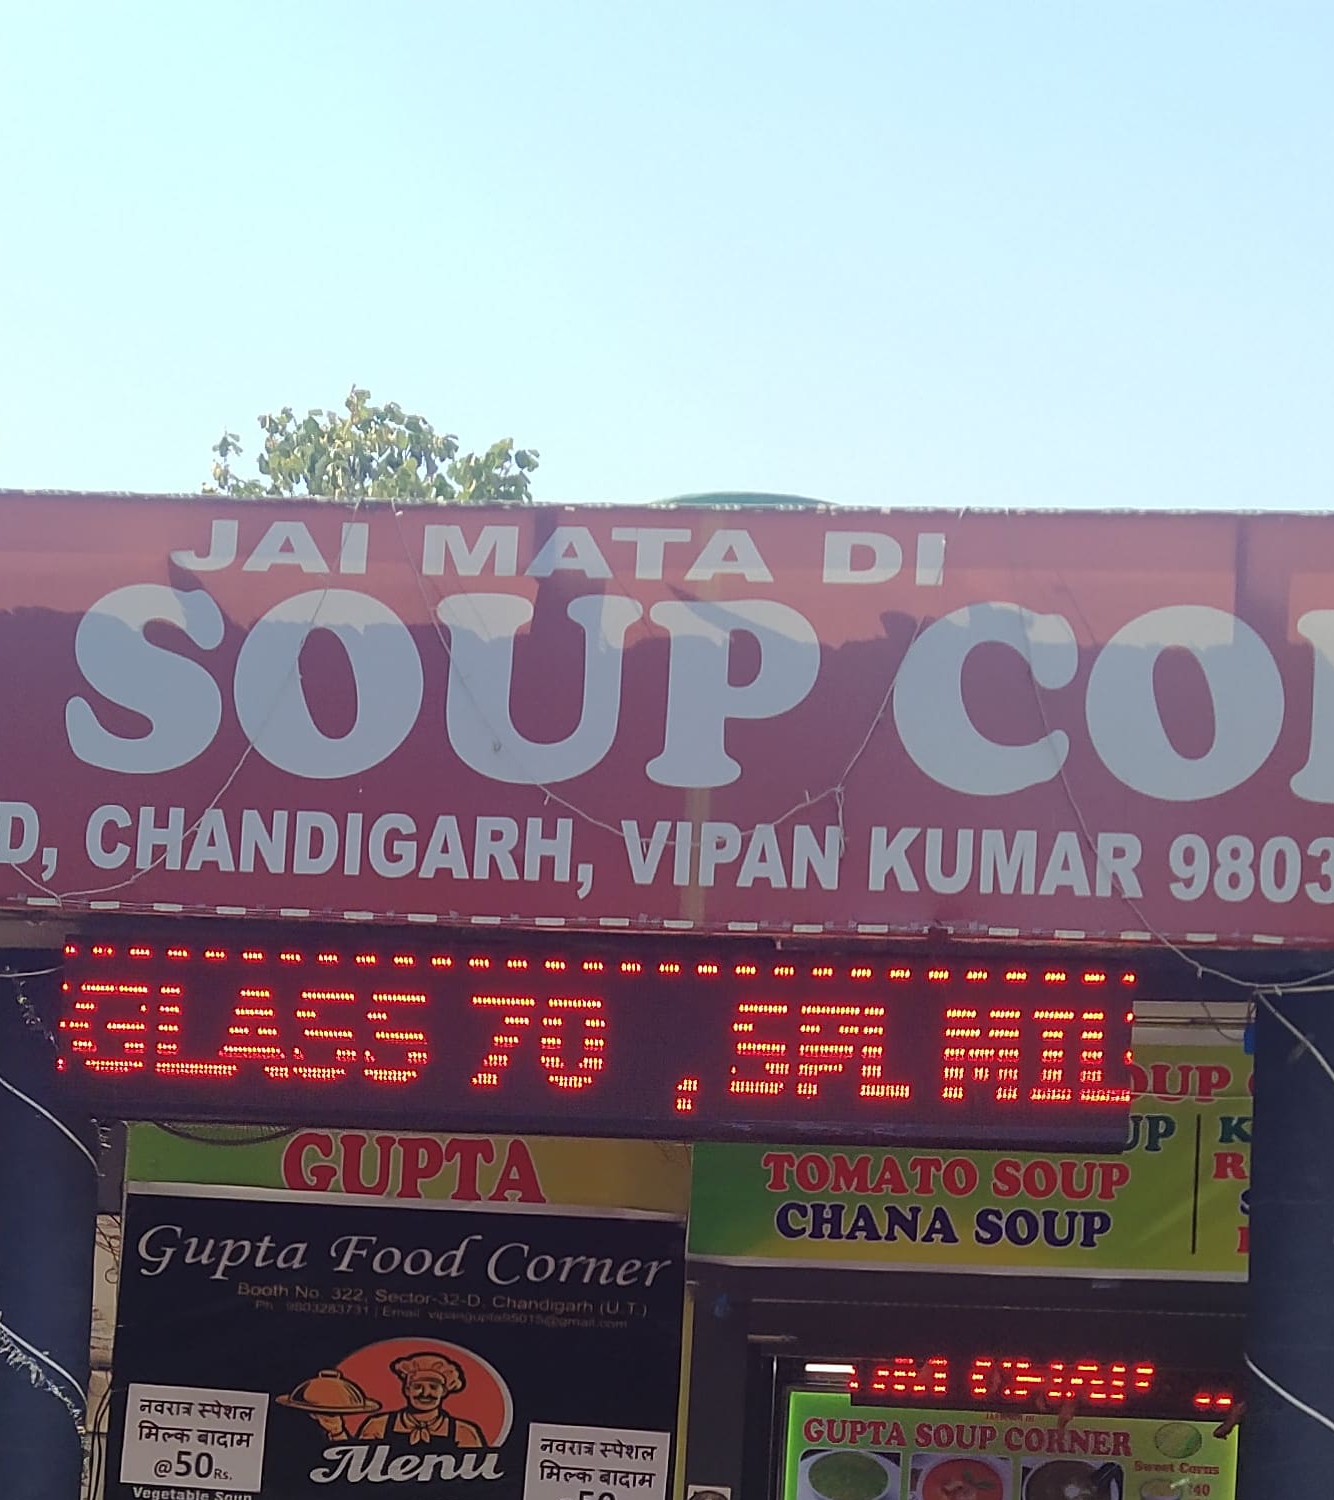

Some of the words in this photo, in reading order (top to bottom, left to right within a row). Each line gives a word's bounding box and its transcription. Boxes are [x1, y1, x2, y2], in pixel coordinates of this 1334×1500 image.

[171, 519, 369, 574] JAI
[421, 524, 773, 583] MATA
[822, 531, 945, 586] DI
[67, 584, 820, 787] SOUP
[85, 803, 593, 898] CHANDIGARH,
[624, 819, 841, 889] VIPAN
[869, 827, 1143, 901] KUMAR
[59, 983, 429, 1082] GLASS
[471, 995, 607, 1088] 70
[282, 1132, 546, 1203] GUPTA
[763, 1153, 978, 1198] TOMATO
[992, 1159, 1130, 1201] SOUP
[776, 1203, 959, 1246] CHANA
[975, 1209, 1111, 1248] SOUP
[137, 1223, 308, 1284] Gupta
[330, 1234, 482, 1279] Food
[487, 1242, 671, 1289] Corner
[237, 1282, 289, 1299] Booth
[492, 1296, 595, 1317] Chandigarh
[138, 1420, 191, 1446] मिल्क
[197, 1429, 252, 1449] बादाम
[198, 1400, 254, 1422] स्पेशल
[803, 1418, 907, 1447] GUPTA
[914, 1423, 997, 1450] SOUP
[1004, 1427, 1132, 1456] CORNER
[309, 1445, 505, 1484] Menu
